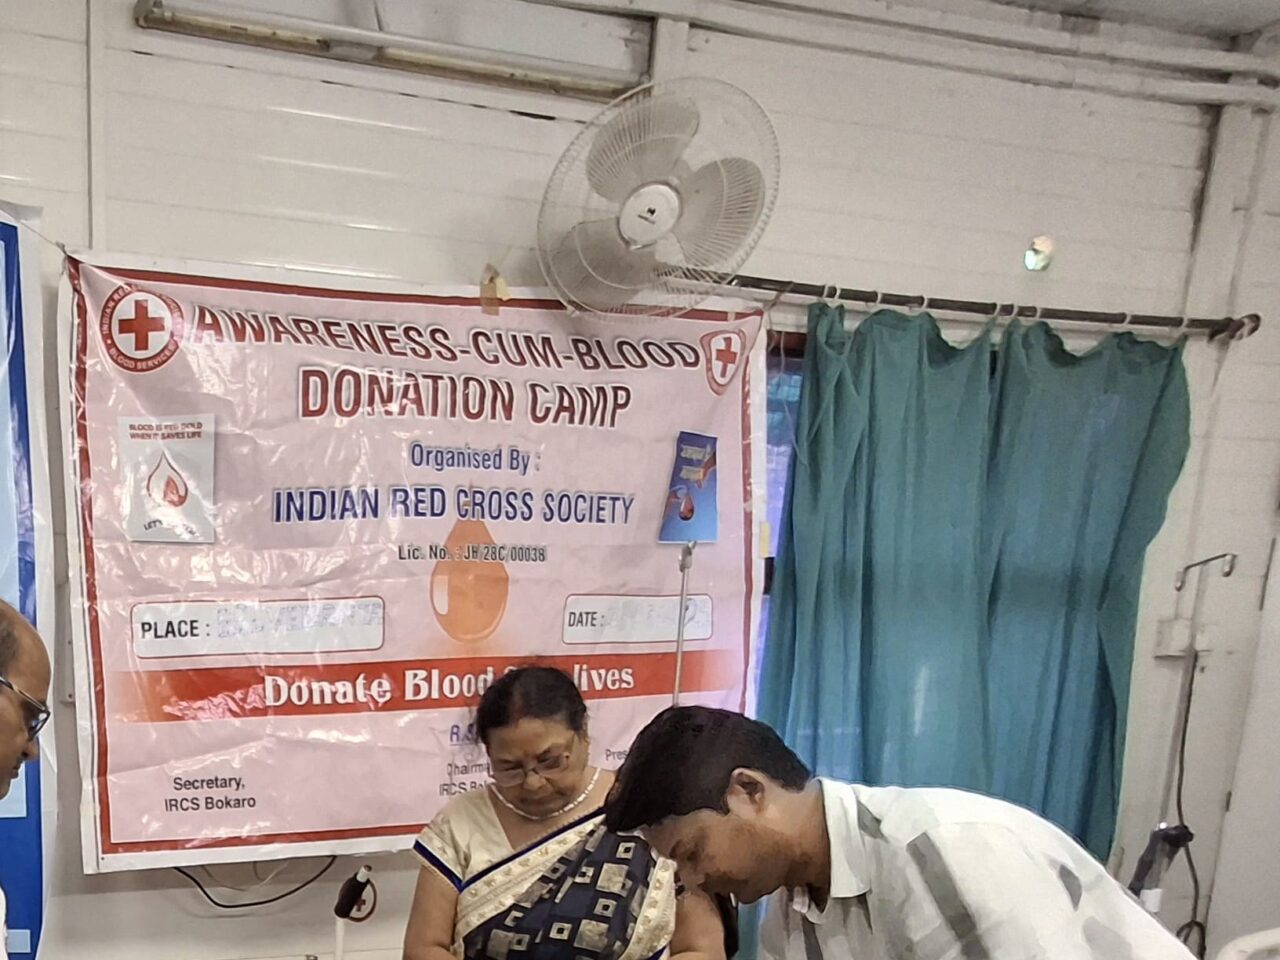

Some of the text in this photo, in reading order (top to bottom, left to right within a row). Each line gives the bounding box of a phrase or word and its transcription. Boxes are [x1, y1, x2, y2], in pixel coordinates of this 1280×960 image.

[191, 304, 701, 371] AWARENESS-CUM-BLOOD
[299, 366, 632, 430] DONATION CAMP
[410, 443, 502, 472] Organised
[508, 447, 530, 475] By
[274, 488, 634, 525] INDIAN RED CROSS SOCIETY
[141, 620, 199, 639] PLACE
[568, 611, 597, 627] DATE
[263, 671, 391, 707] Donate
[404, 667, 494, 701] Blood
[173, 774, 246, 793] Secretary,
[165, 793, 256, 811] IRCS Bokaro
